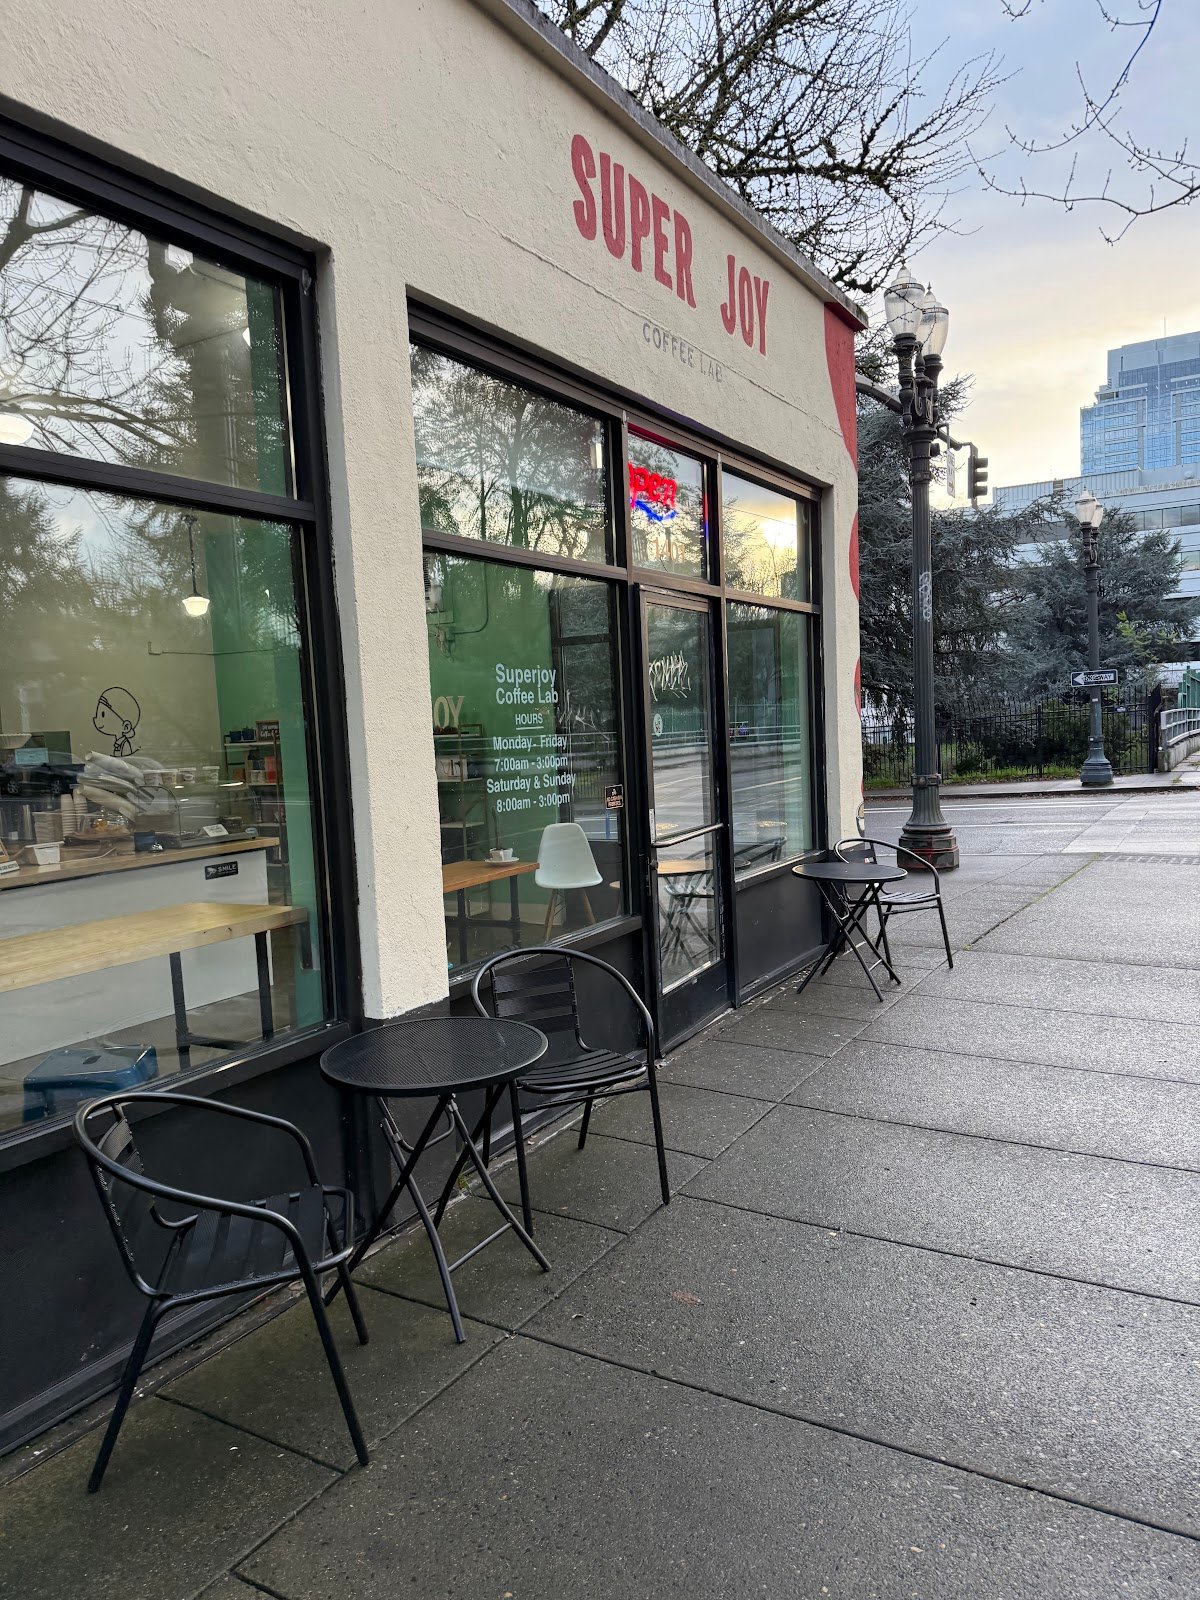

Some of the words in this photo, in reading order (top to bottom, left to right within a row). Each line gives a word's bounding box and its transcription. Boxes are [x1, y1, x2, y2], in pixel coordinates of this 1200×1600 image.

[571, 134, 697, 308] SUPER
[720, 254, 770, 357] JOY
[642, 322, 694, 367] COFFEE
[700, 352, 723, 383] LAB
[627, 461, 678, 510] pen
[495, 663, 557, 687] Superjoy
[495, 687, 535, 705] Coffee
[538, 687, 559, 704] Lab
[433, 695, 466, 729] OY
[515, 713, 543, 725] HOURS
[540, 733, 567, 750] Friday
[494, 758, 529, 772] 7:00am
[536, 755, 568, 770] 3:00pm
[486, 776, 531, 793] Saturday
[533, 776, 541, 789] &
[543, 772, 577, 788] Sunday
[496, 798, 531, 813] 8:00am
[538, 792, 570, 807] 3:00pm
